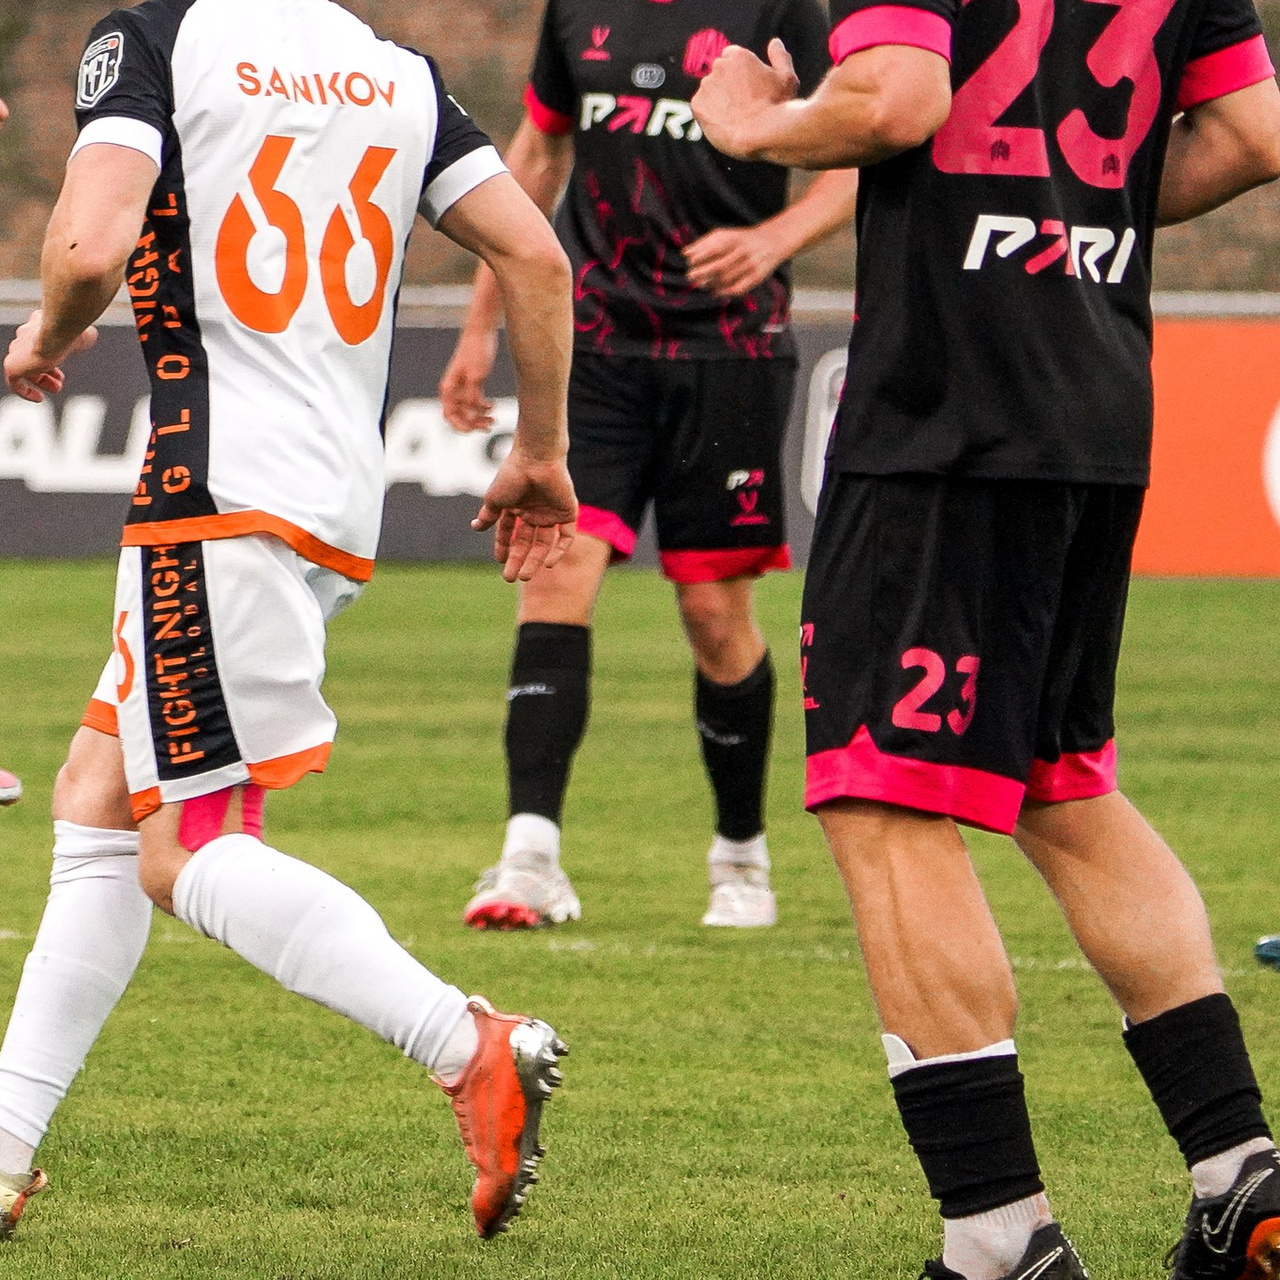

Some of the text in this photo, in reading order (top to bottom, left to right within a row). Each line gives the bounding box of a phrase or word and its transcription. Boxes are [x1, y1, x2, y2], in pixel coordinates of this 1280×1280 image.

[236, 62, 395, 107] SANKOV
[215, 135, 398, 346] 66
[153, 652, 206, 765] FIGHT
[892, 646, 981, 736] 23
